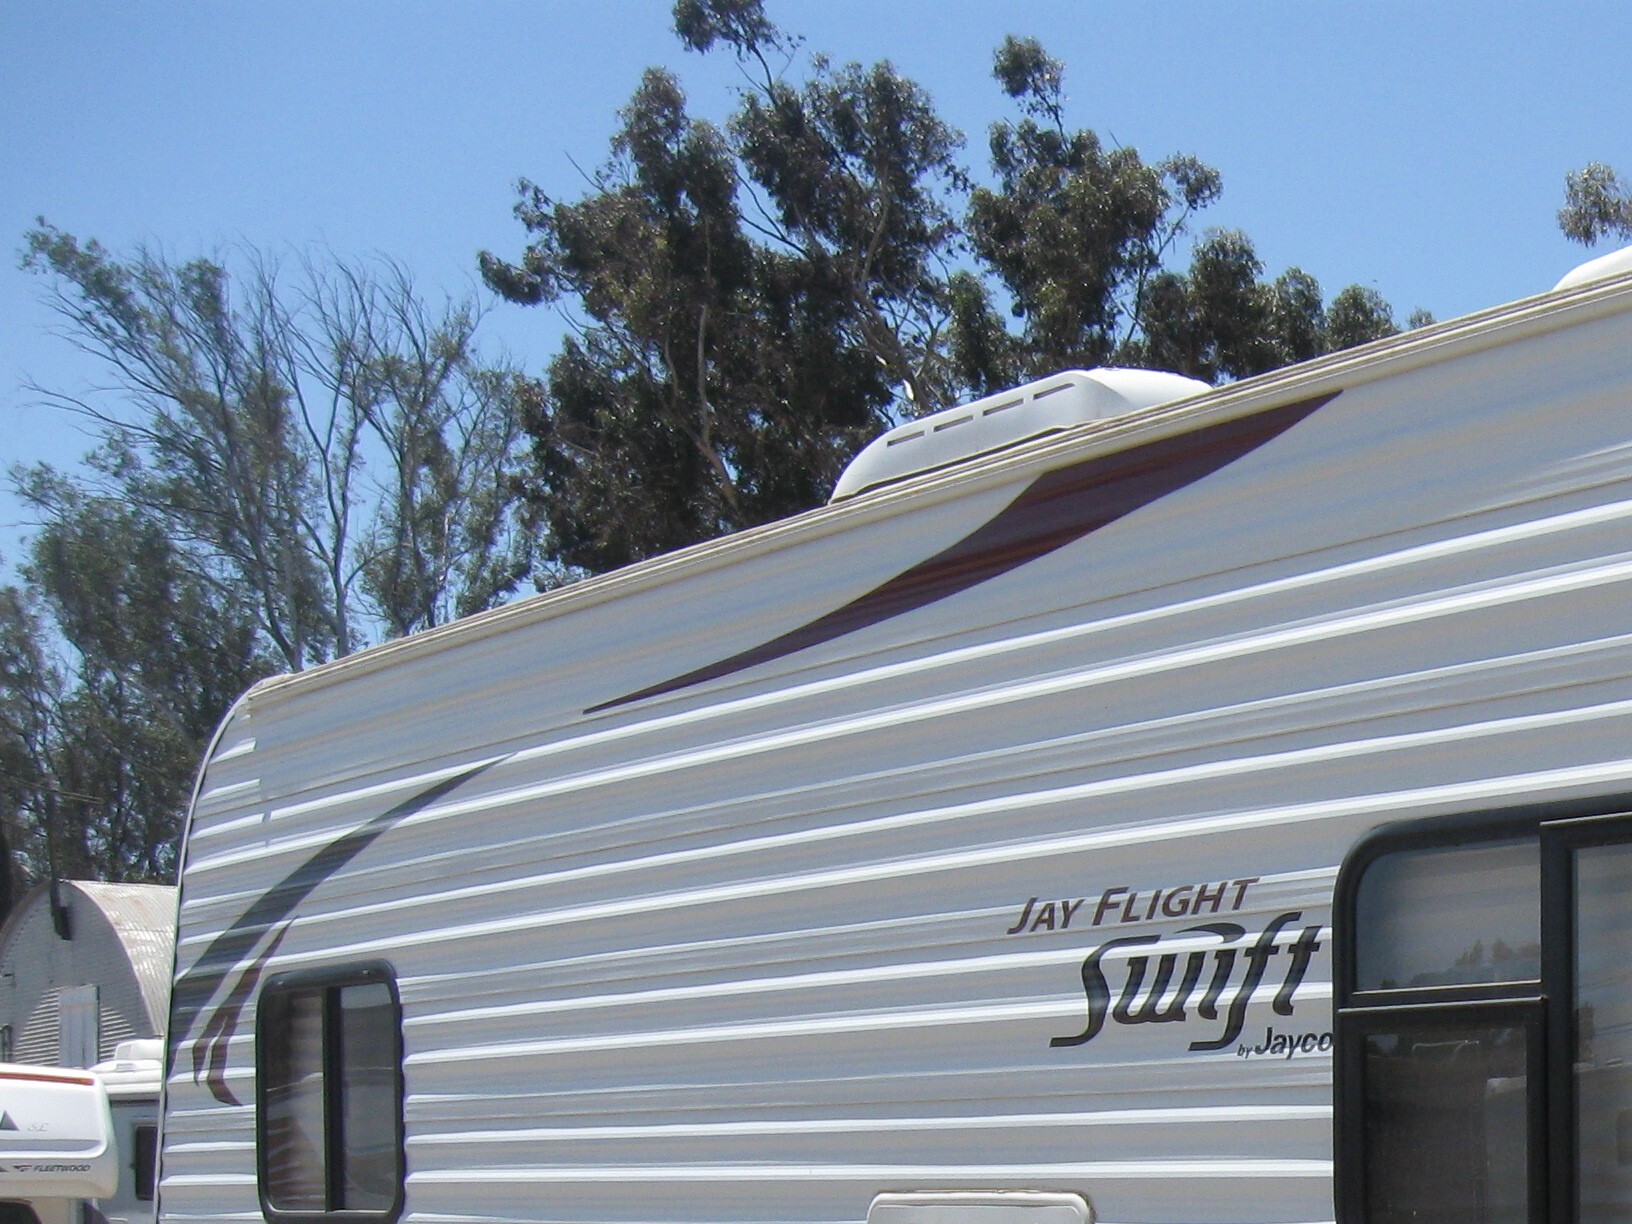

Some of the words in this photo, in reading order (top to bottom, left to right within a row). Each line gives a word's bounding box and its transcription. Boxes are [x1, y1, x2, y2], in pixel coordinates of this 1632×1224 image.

[1006, 897, 1085, 935] JAY
[1092, 877, 1261, 926] FLIGHT
[1050, 911, 1324, 1051] Swift
[1237, 1043, 1254, 1060] by
[1254, 1026, 1334, 1060] Jayco
